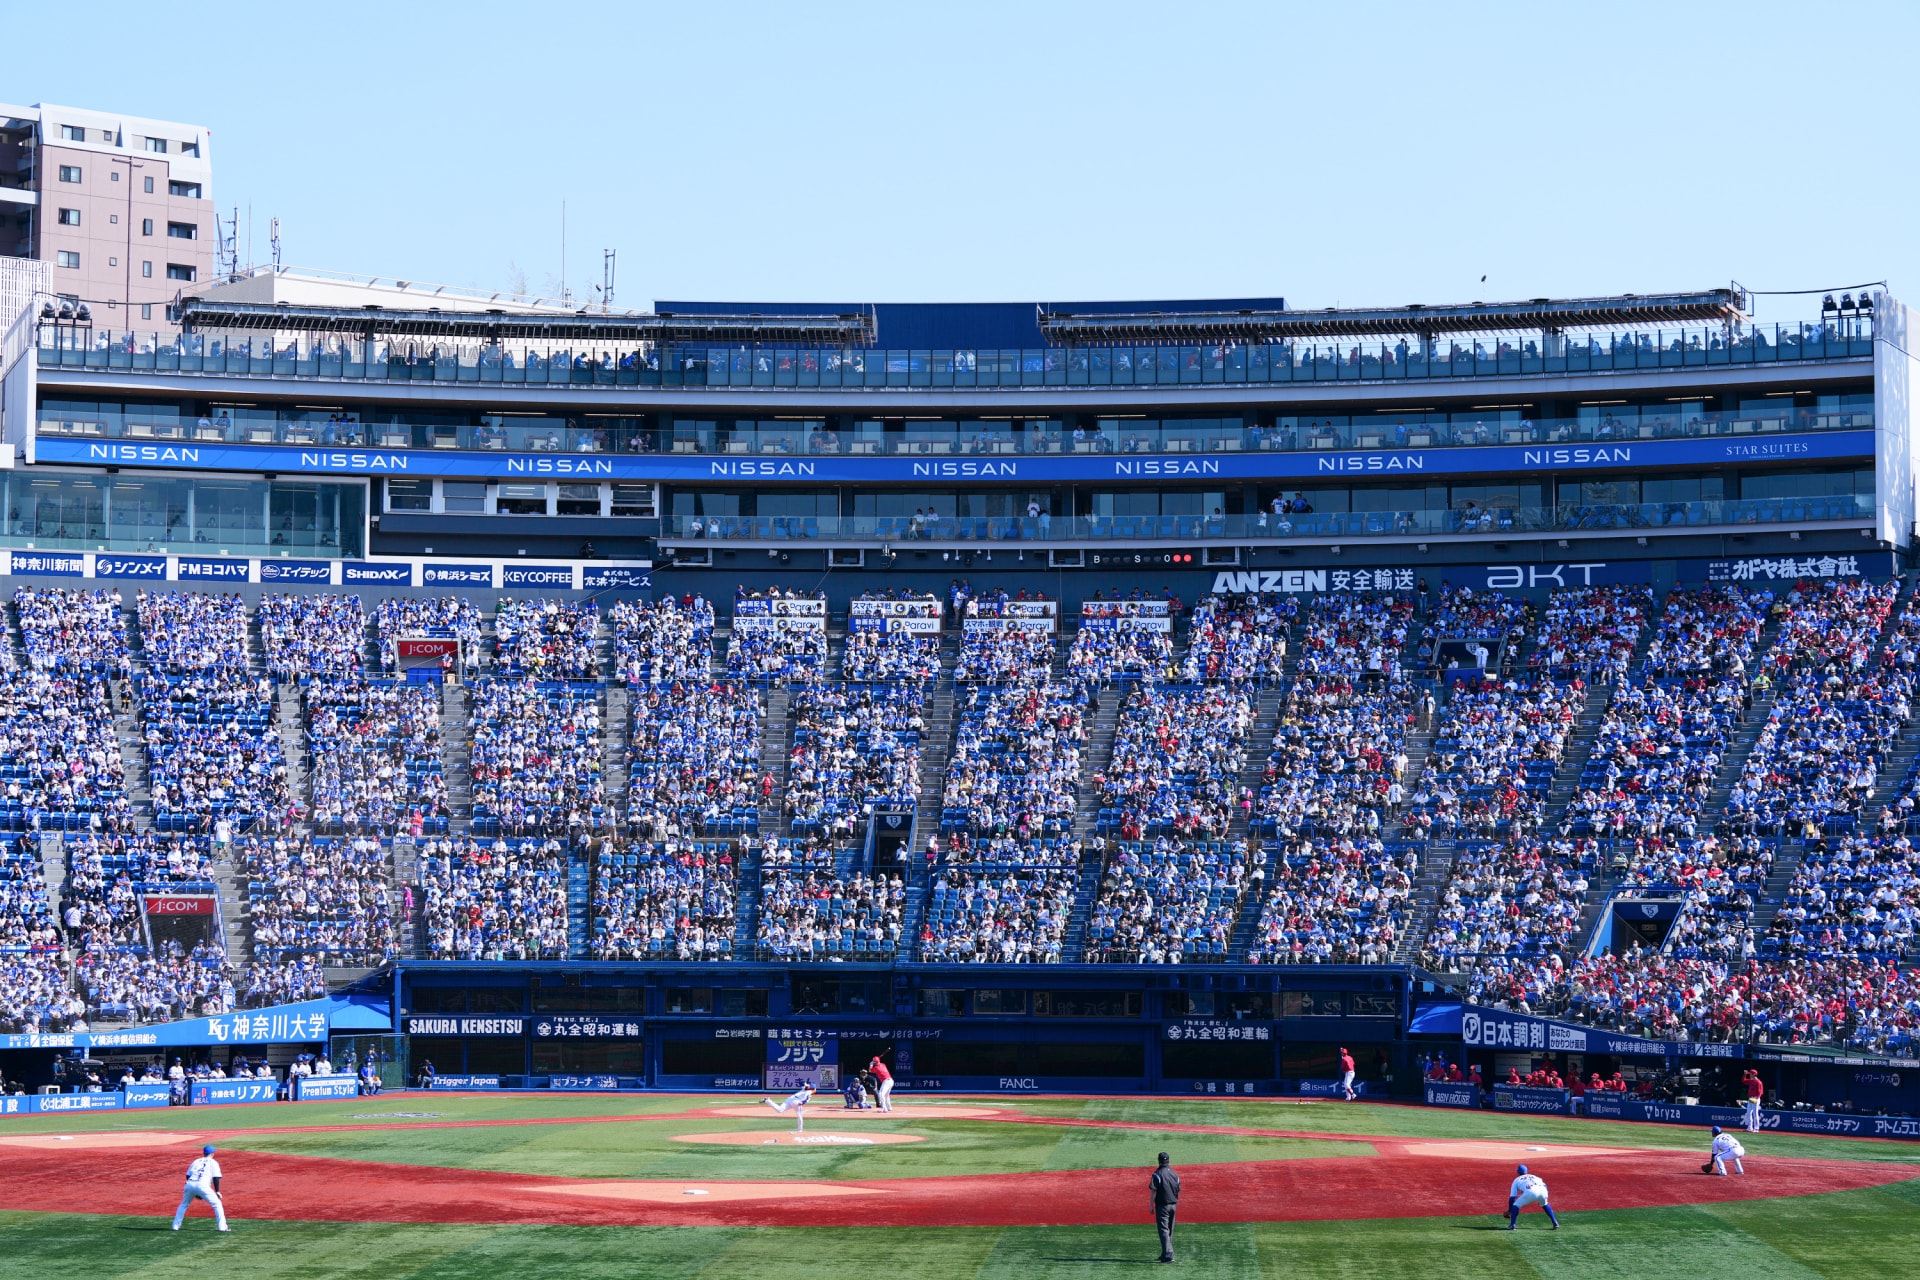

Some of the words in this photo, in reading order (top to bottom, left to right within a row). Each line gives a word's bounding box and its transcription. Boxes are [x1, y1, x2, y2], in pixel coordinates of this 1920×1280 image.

[90, 445, 199, 462] NISSAN
[1726, 445, 1758, 456] STAR
[1762, 442, 1808, 454] SUITES
[302, 452, 407, 469] NISSAN
[1319, 456, 1424, 471] NISSAN
[1524, 448, 1631, 466] NISSAN
[508, 459, 612, 474] NISSAN
[711, 462, 815, 476] NISSAN
[914, 462, 1017, 476] NISSAN
[1115, 460, 1220, 475] NISSAN
[12, 556, 84, 572] 神奈川新聞
[1094, 556, 1100, 564] B
[1134, 555, 1141, 563] S
[115, 562, 166, 576] シンメイ
[179, 564, 249, 577] FMヨコハマ
[280, 567, 330, 578] エイテック
[346, 568, 399, 580] SHIDAX
[1732, 556, 1860, 580] カドヤ株式會社
[437, 570, 490, 582] 横浜シミズ
[584, 576, 652, 587] 京浜サービス
[1212, 570, 1326, 593] ANZEN
[1332, 568, 1414, 591] 安全輸送
[1020, 622, 1050, 630] Paravi
[408, 644, 444, 654] J:COM
[156, 902, 198, 913] J:COM
[232, 1013, 325, 1040] 神奈川大学
[410, 1019, 458, 1034] SAKURA
[462, 1019, 522, 1034] KENSETSU
[554, 1023, 639, 1036] 丸全昭和運輸
[768, 1029, 837, 1038] 臨海セミナー
[1184, 1026, 1268, 1040] 丸全昭和運輸
[1550, 1028, 1570, 1038] あなたの
[41, 1035, 74, 1046] 全国保証
[730, 1030, 760, 1038] 岩崎学園
[1484, 1020, 1544, 1048] 日本調剤
[778, 1048, 824, 1062] ノジマ
[1704, 1045, 1733, 1056] 全国保証
[433, 1076, 468, 1086] Trigger
[470, 1076, 498, 1086] Japan
[1000, 1078, 1038, 1089] FANCL
[238, 1086, 274, 1100] リアル
[302, 1087, 332, 1096] Premium
[334, 1084, 354, 1096] Style
[133, 1093, 169, 1102] インタープラン
[1449, 1094, 1470, 1104] HOUSE
[1655, 1106, 1680, 1120] bryza
[1827, 1118, 1860, 1132] カナデン
